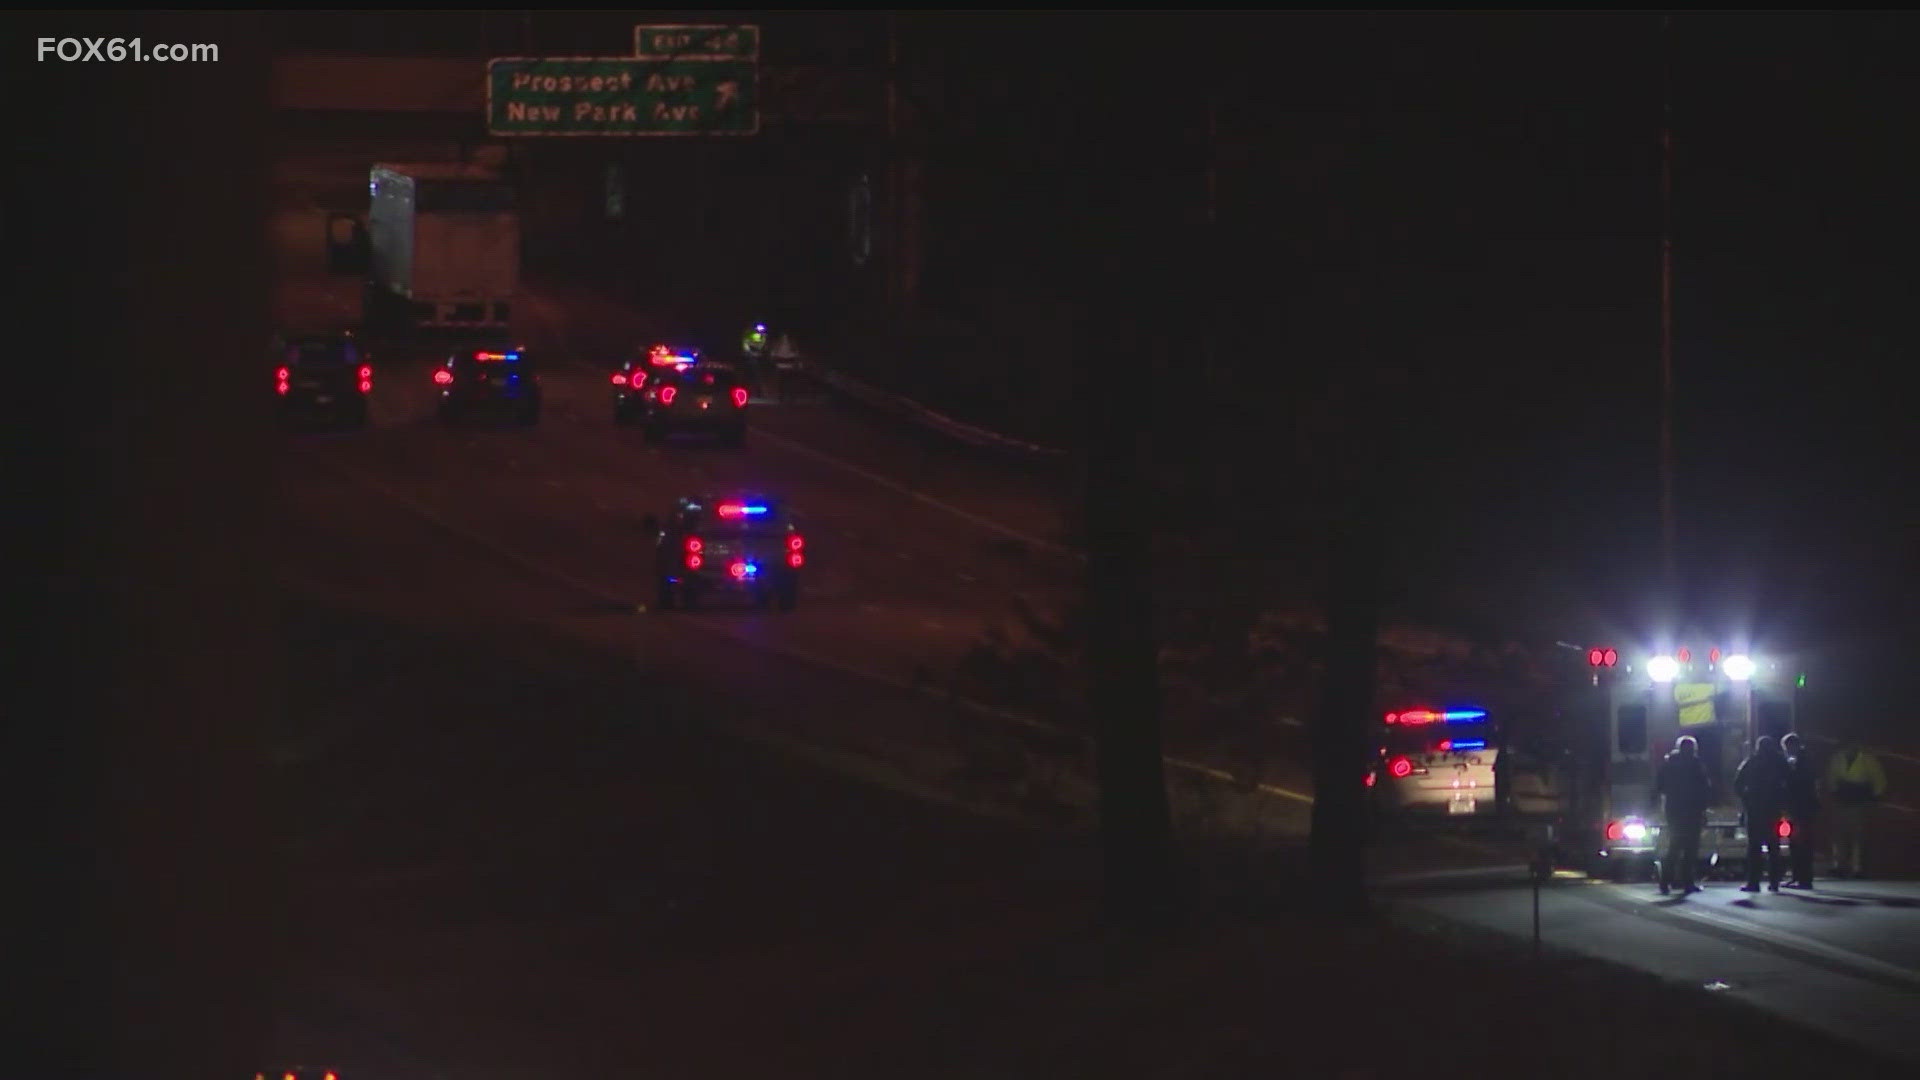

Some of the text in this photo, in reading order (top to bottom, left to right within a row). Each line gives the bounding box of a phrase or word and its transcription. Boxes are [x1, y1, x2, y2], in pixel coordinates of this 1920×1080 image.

[512, 73, 696, 93] Prospect Ave
[507, 102, 700, 122] New Park Ave
